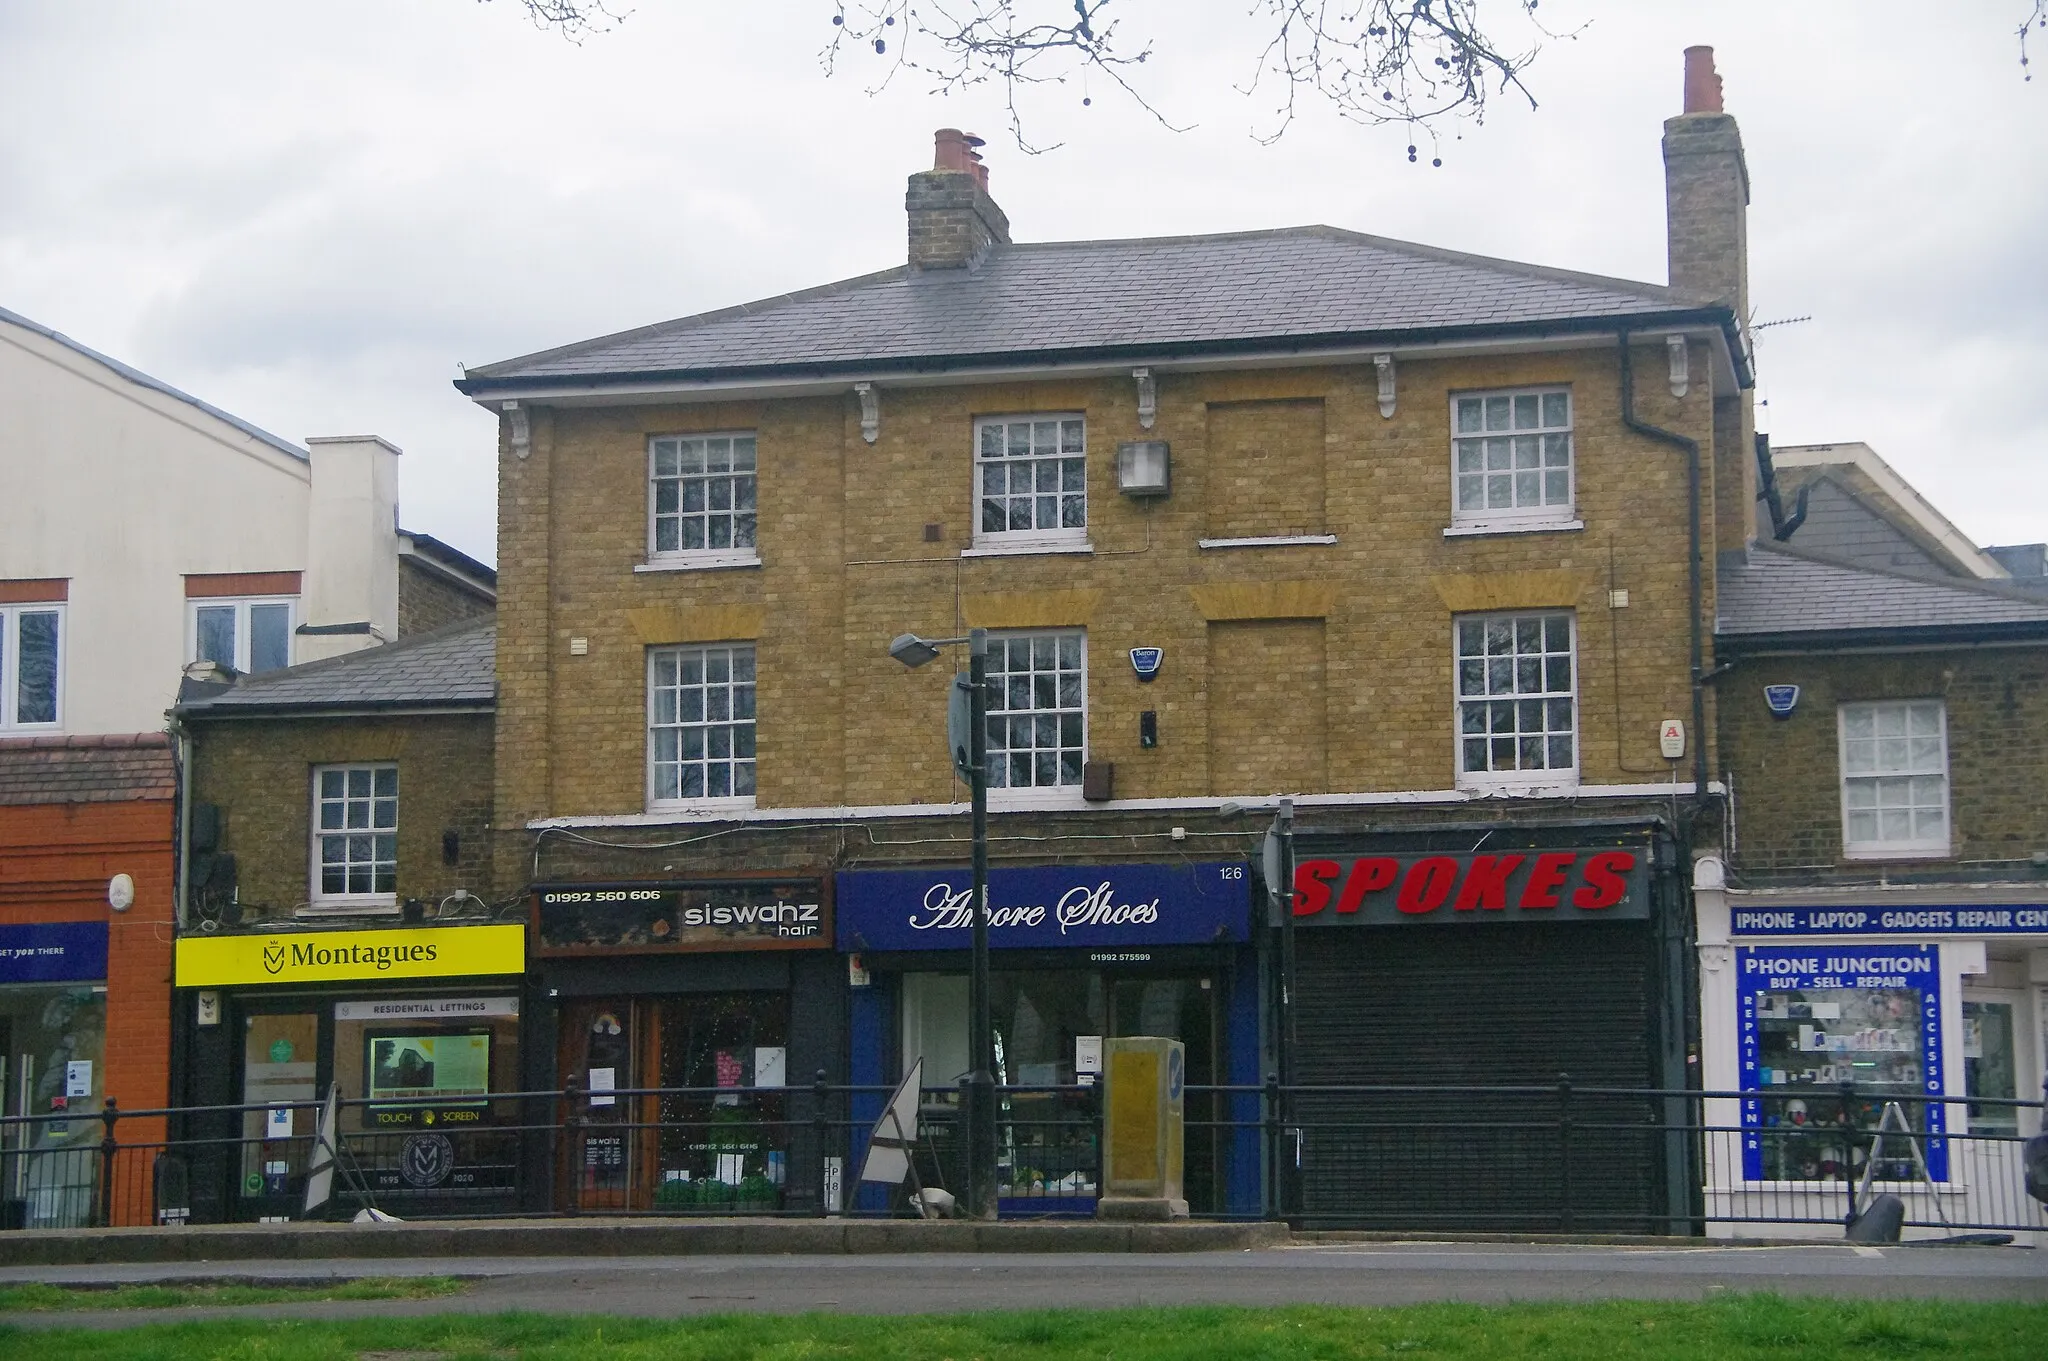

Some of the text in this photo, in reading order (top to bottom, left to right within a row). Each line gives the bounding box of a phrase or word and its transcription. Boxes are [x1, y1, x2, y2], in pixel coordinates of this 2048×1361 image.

[1220, 867, 1242, 880] 126
[1292, 852, 1636, 916] SPOKES
[545, 890, 661, 903] 01992 560 606
[684, 901, 819, 925] siswahz
[1056, 881, 1160, 935] Shoes
[1736, 912, 1796, 928] IPHONE
[1809, 912, 1868, 927] LAPTOP
[1881, 911, 1953, 928] GADGETS
[1956, 911, 2012, 927] REPAIR
[2015, 910, 2048, 927] CEN
[778, 924, 817, 936] hair
[14, 949, 35, 959] you
[38, 947, 65, 955] THERE
[291, 943, 438, 970] Montagues
[1090, 953, 1151, 961] 01992 575599
[1745, 957, 1931, 974] PHONE JUNCTION
[1770, 977, 1799, 988] BUY
[1813, 977, 1843, 988] SELL
[1856, 976, 1907, 988] REPAIR
[373, 1002, 486, 1014] RESIDENTIAL LETTINGS
[1743, 997, 1755, 1071] REPAIR
[1925, 993, 1941, 1149] ACCESSOIES
[376, 1111, 480, 1123] TOUCH SCREEN
